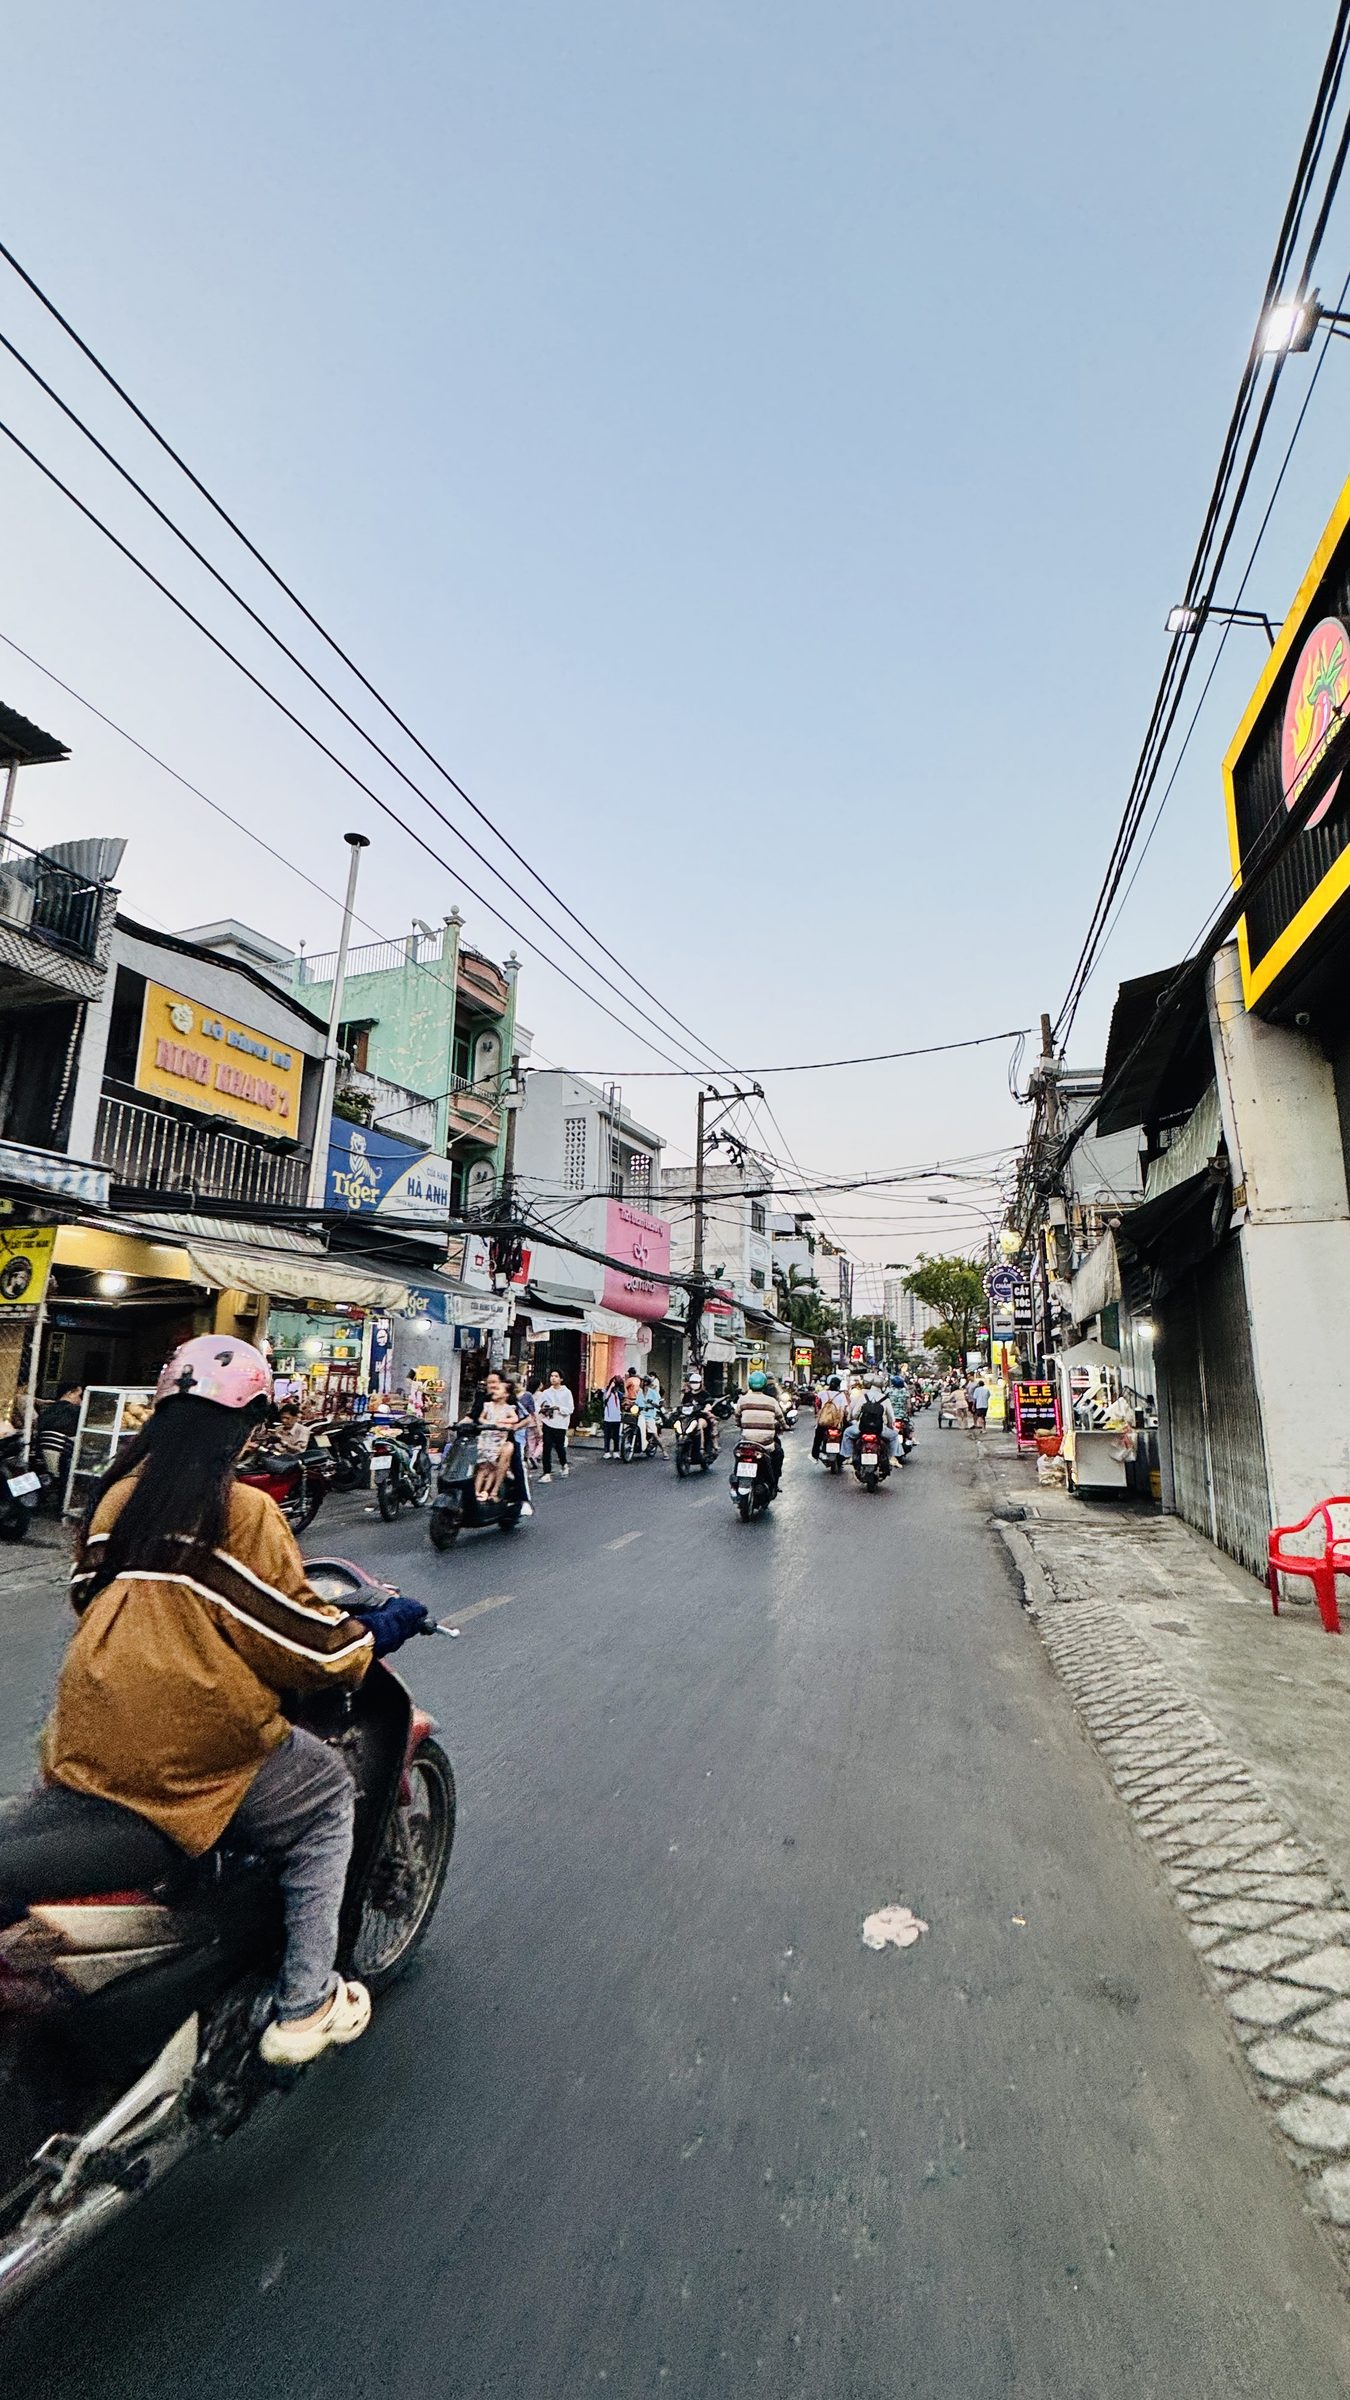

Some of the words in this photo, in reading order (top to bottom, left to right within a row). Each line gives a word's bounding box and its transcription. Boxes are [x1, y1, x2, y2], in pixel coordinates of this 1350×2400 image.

[214, 1063, 277, 1111] KHANG
[279, 1090, 290, 1117] 2
[332, 1170, 380, 1209] Tiger
[407, 1175, 422, 1199] HÀ
[425, 1184, 448, 1206] ANH
[1014, 1284, 1029, 1296] CẮT
[1015, 1297, 1031, 1307] TÓC
[1015, 1309, 1032, 1318] NAM
[1018, 1385, 1052, 1397] L.E.E
